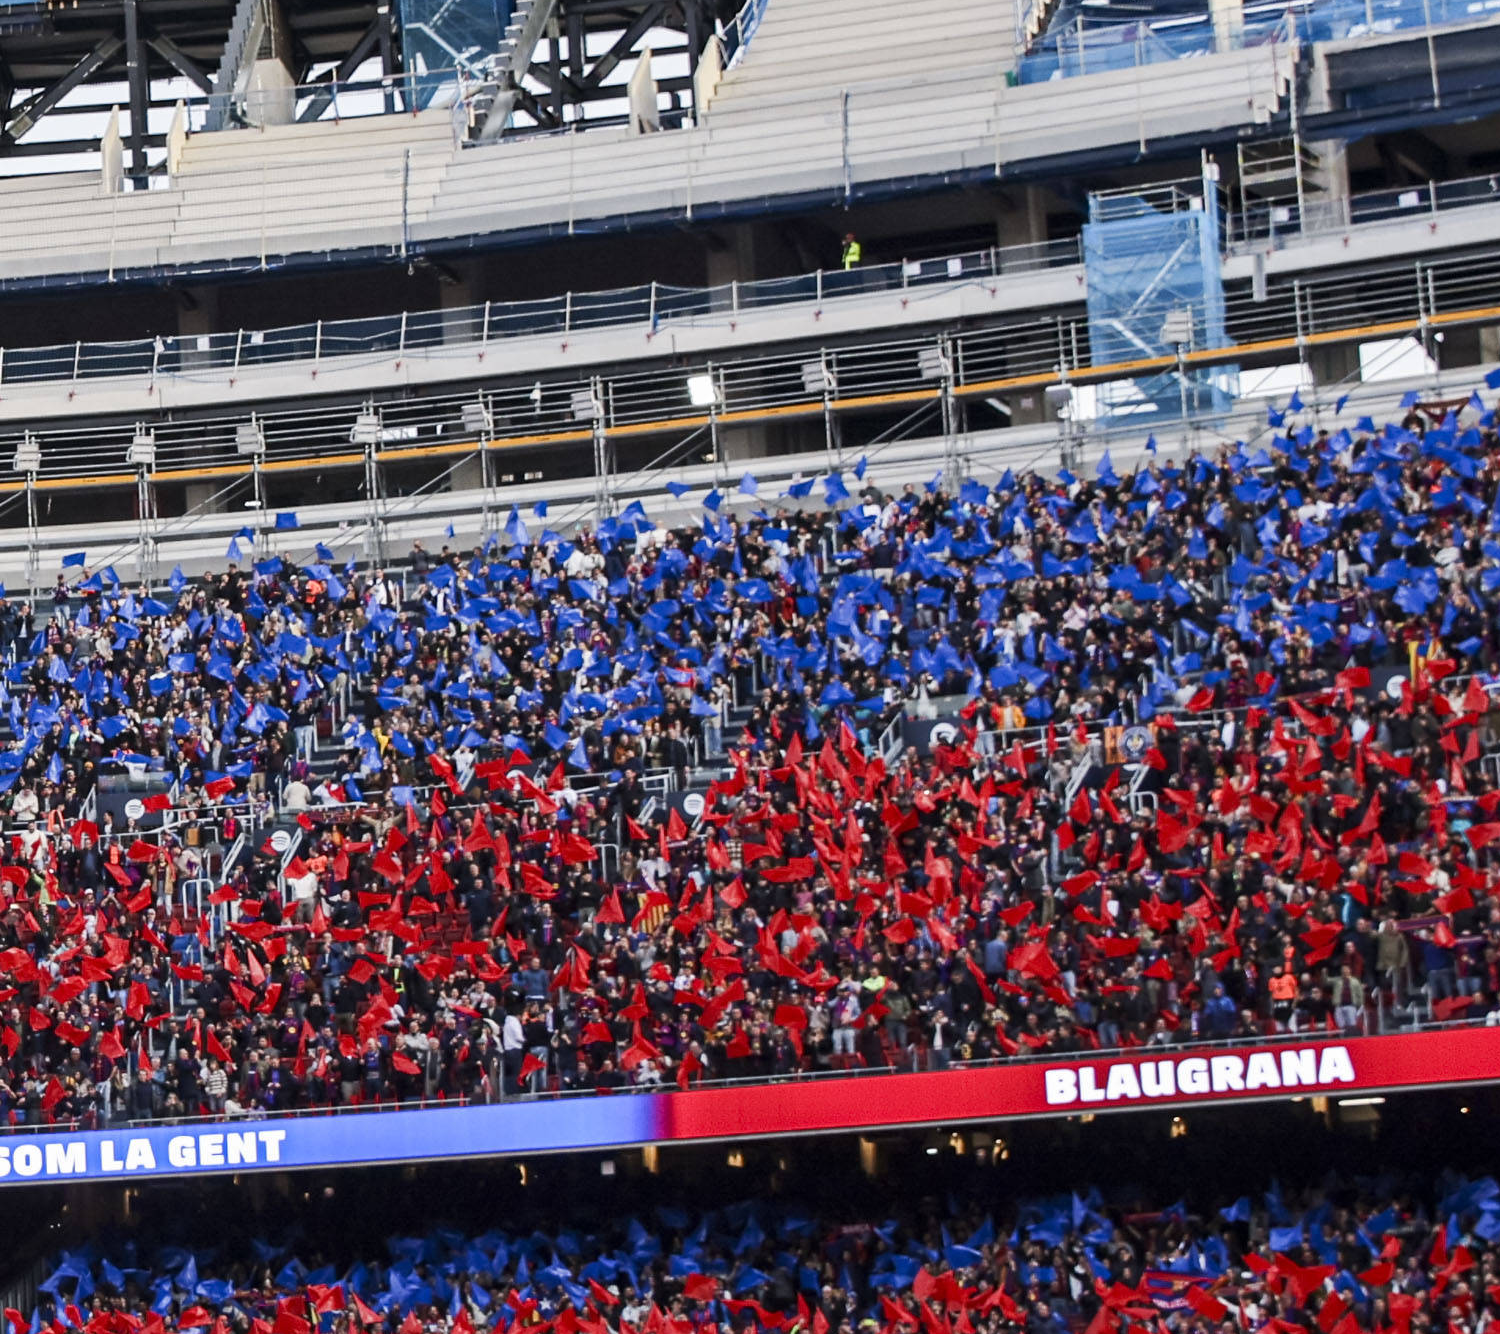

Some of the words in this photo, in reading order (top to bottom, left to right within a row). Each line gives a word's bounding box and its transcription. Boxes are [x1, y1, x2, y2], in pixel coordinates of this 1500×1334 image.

[1045, 1046, 1355, 1104] BLAUGRANA
[100, 1138, 156, 1171] LA
[168, 1130, 286, 1167] GENT
